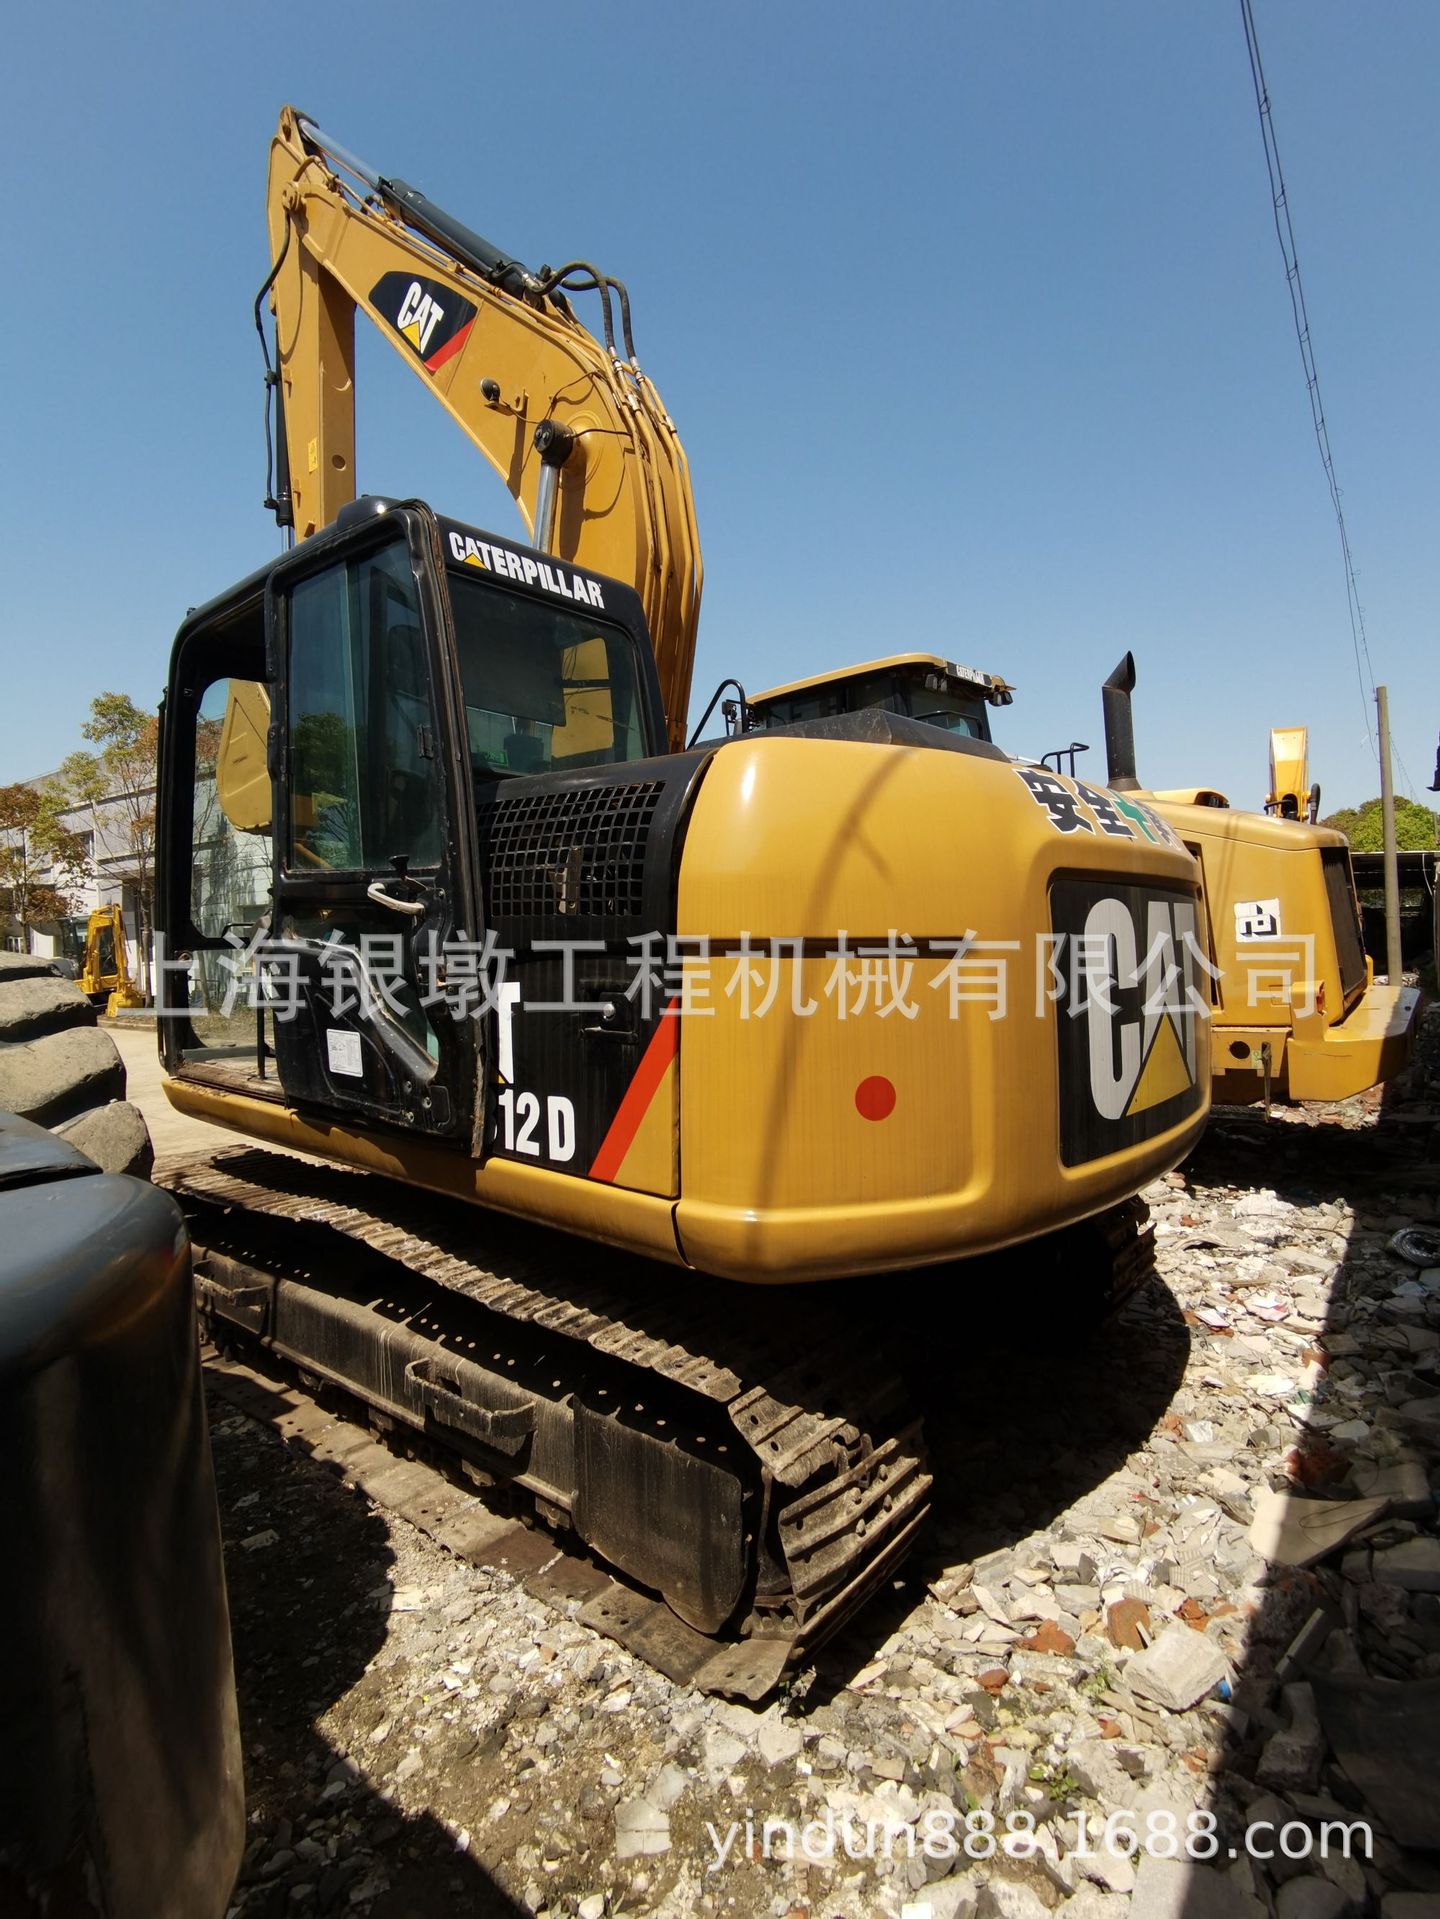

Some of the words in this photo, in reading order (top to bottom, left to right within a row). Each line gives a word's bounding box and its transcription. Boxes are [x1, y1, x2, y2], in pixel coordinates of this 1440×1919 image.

[397, 281, 445, 354] CAT
[449, 531, 605, 609] CATERPILLAR
[1084, 898, 1196, 1120] CAT
[492, 1088, 576, 1162] 12D
